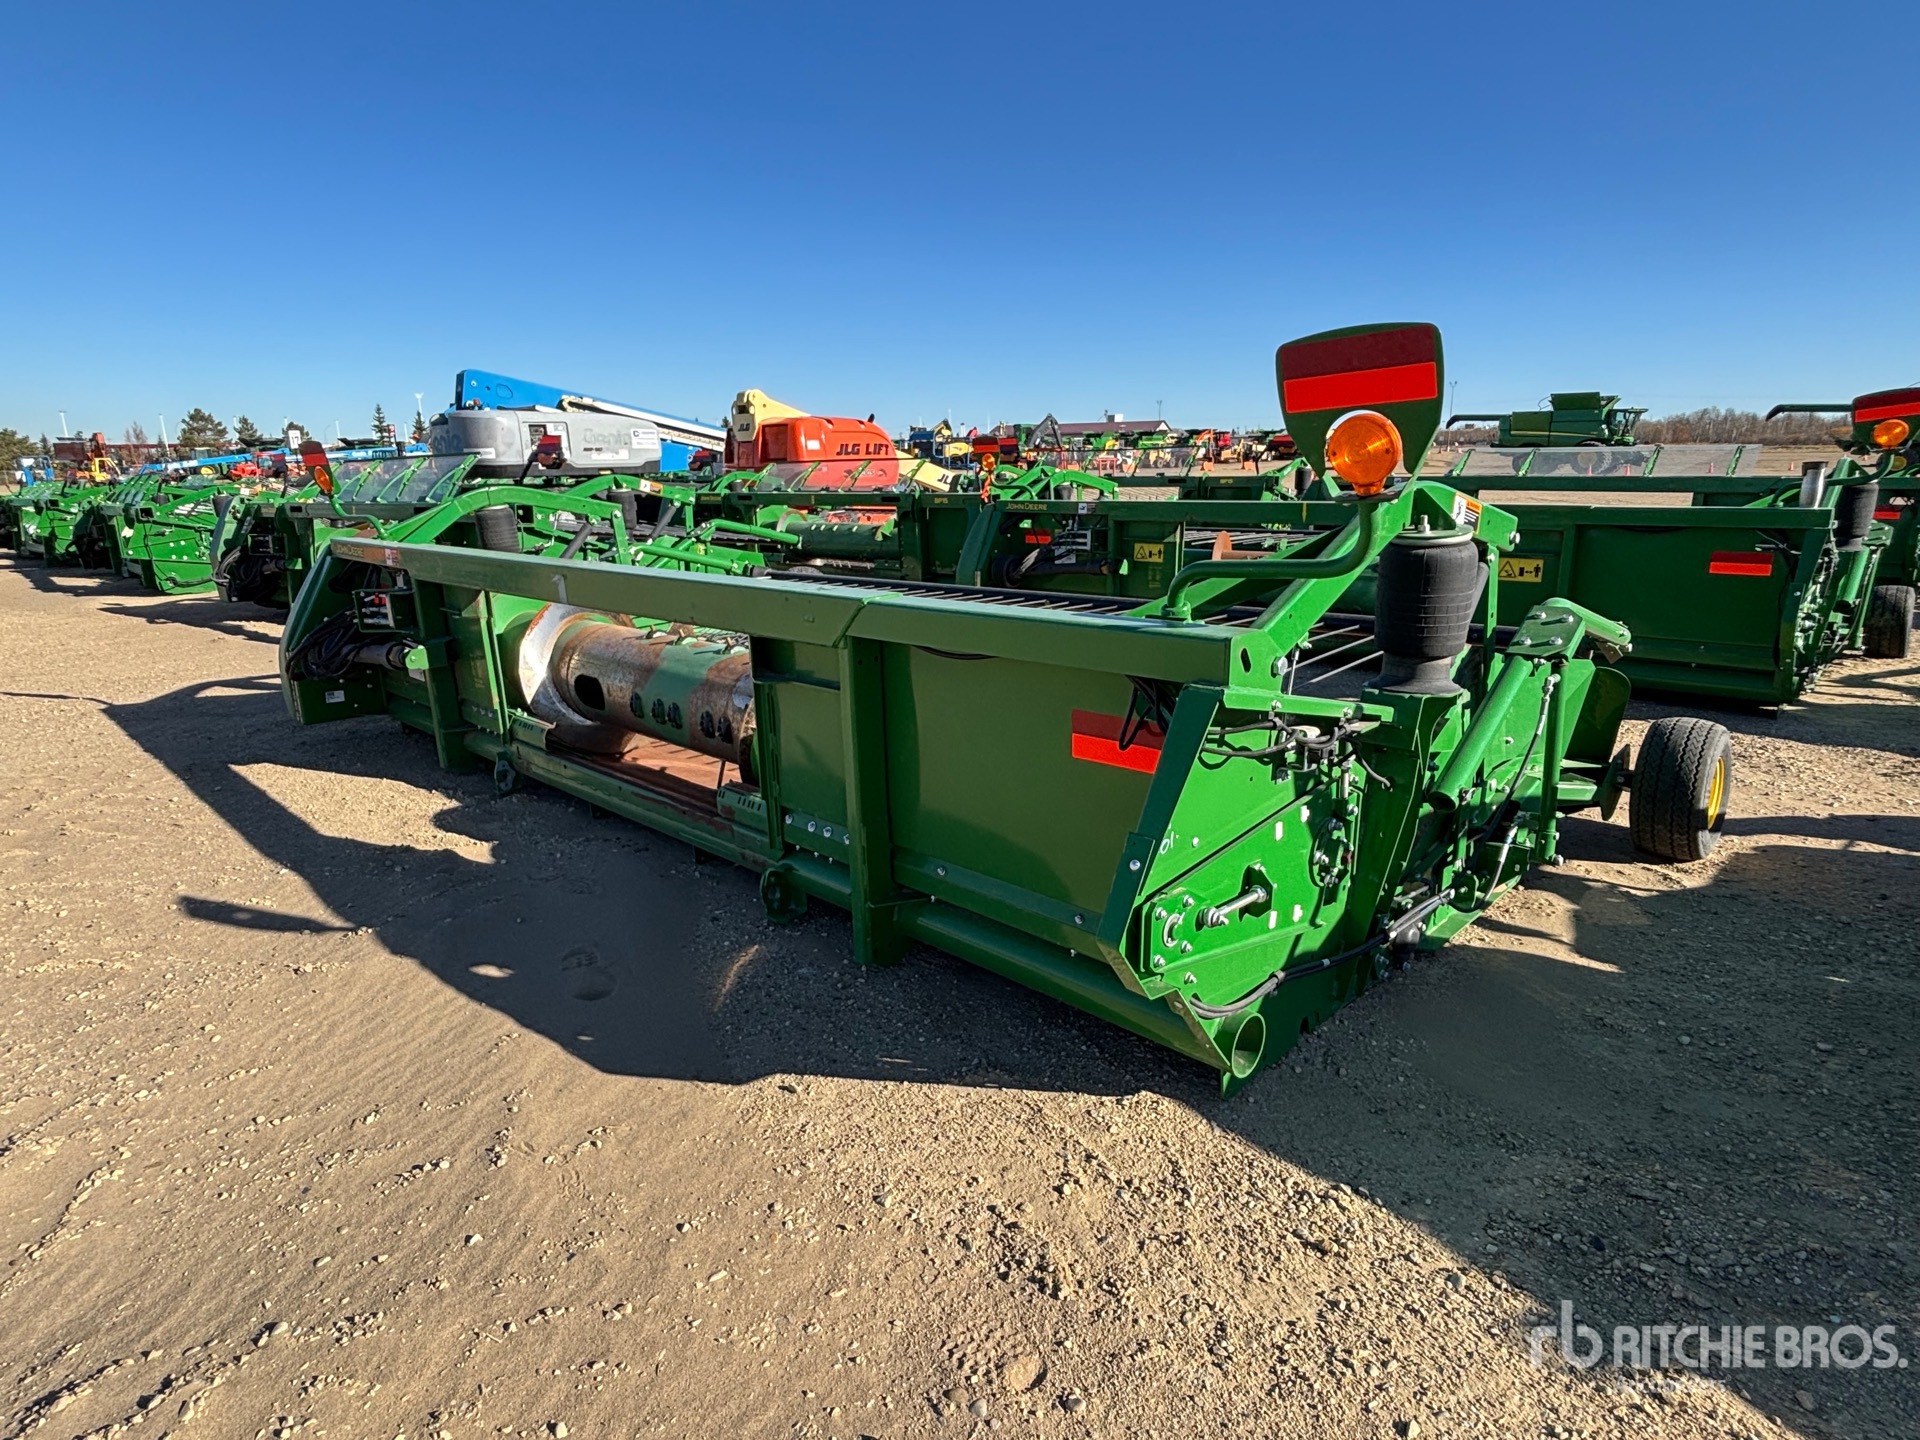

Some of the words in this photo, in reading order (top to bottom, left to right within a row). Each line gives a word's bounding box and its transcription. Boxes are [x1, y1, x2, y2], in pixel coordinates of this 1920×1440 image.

[738, 423, 750, 432] JLG
[432, 428, 463, 453] enie
[836, 443, 860, 456] JLG
[865, 443, 889, 456] LIFT
[937, 473, 952, 485] JL
